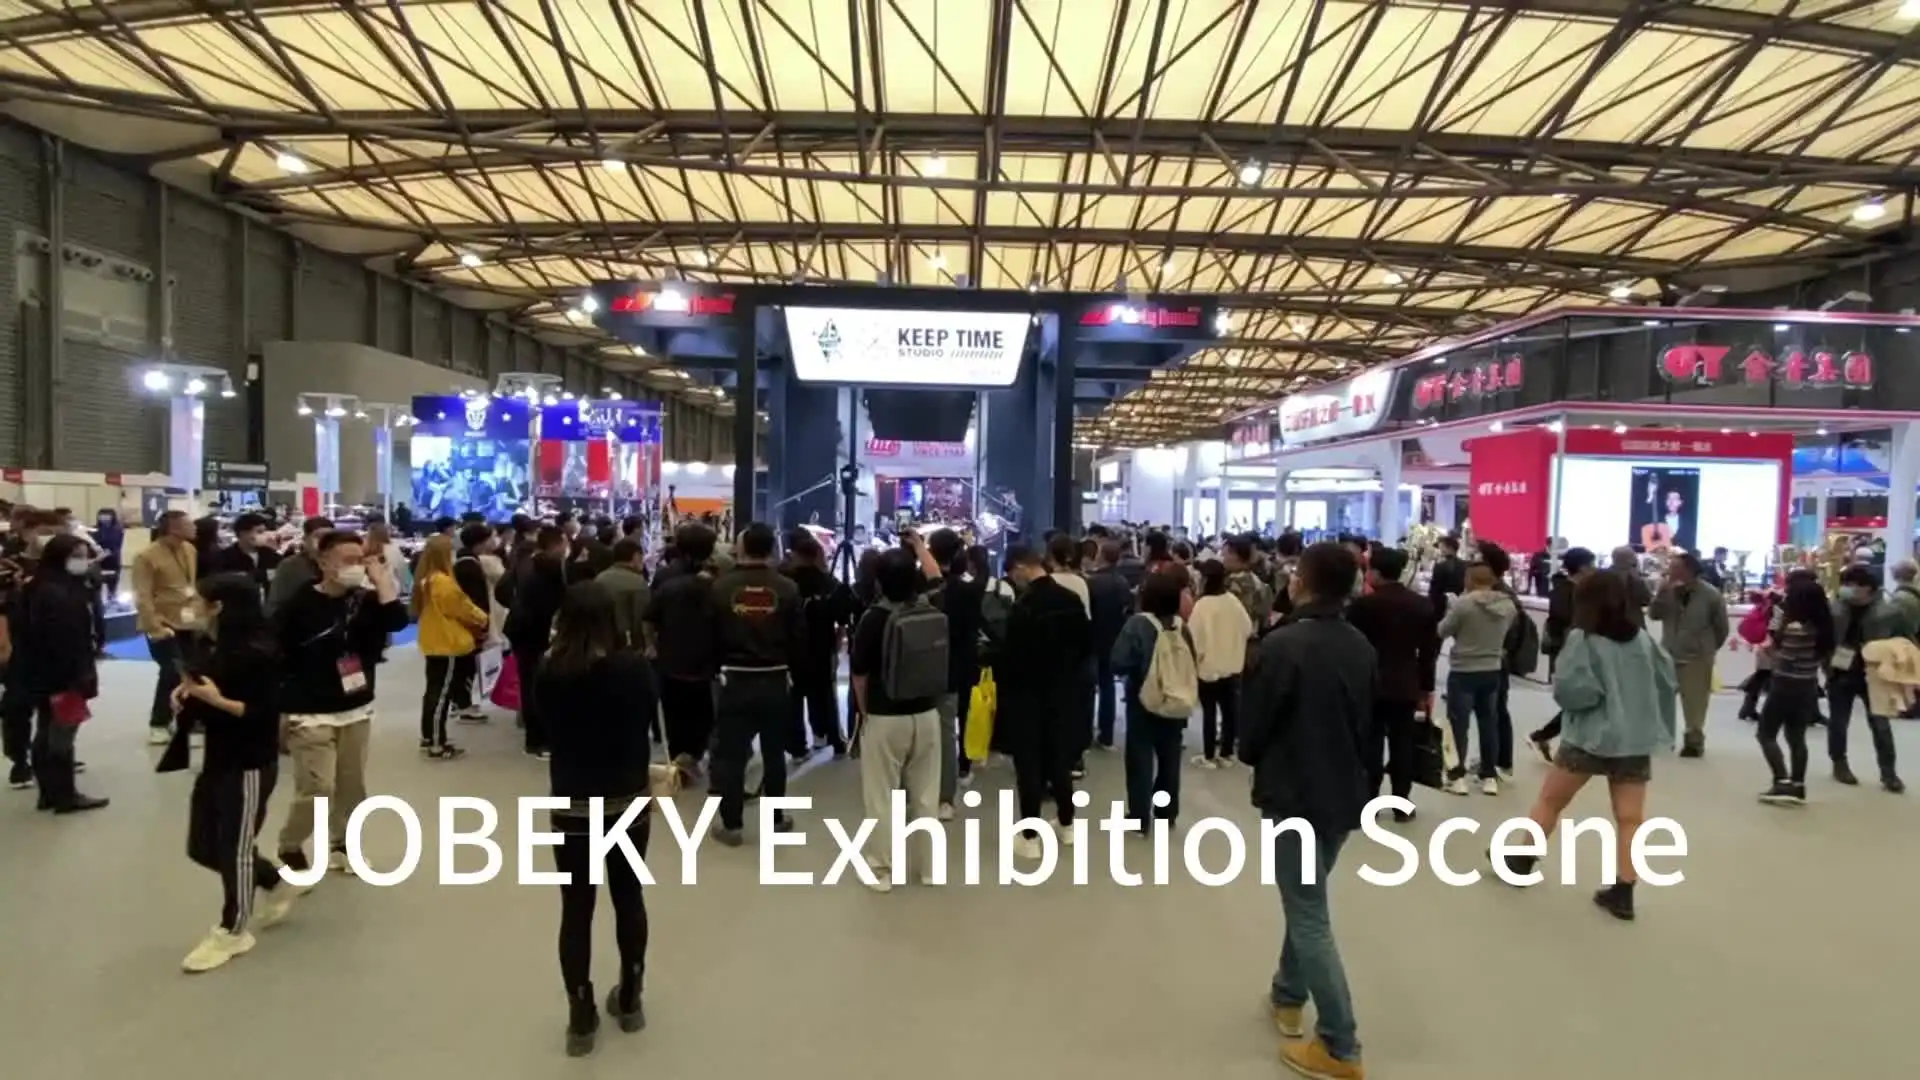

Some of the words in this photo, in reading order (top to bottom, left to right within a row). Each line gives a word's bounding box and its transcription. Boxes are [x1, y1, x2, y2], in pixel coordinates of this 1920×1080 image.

[898, 327, 949, 347] KEEP
[955, 329, 1004, 349] TIME
[898, 348, 944, 358] STUDIO
